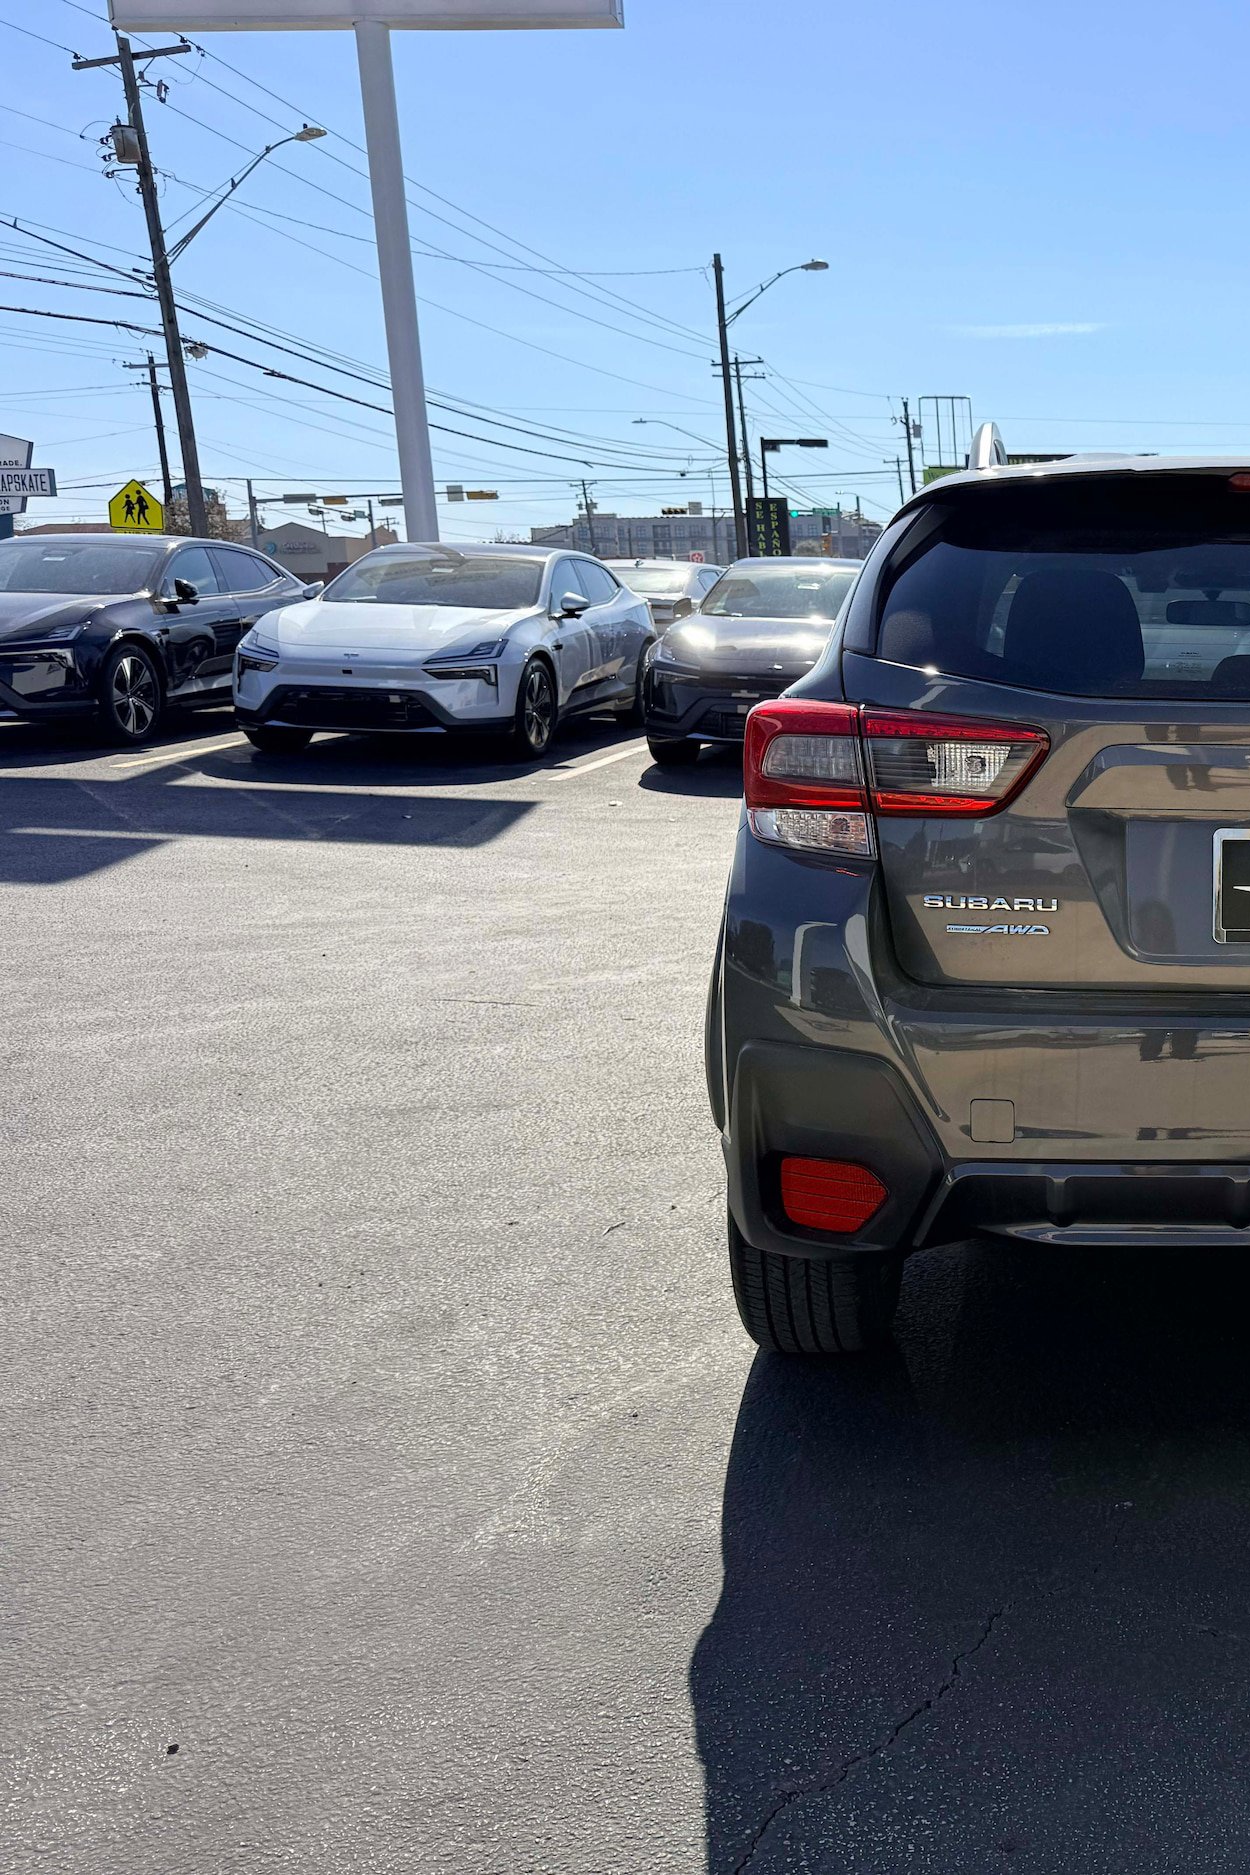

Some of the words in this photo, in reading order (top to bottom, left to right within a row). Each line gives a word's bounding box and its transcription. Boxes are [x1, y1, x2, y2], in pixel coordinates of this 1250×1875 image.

[755, 502, 764, 519] SE
[923, 894, 1058, 912] SUBARU
[982, 924, 1050, 935] AWD
